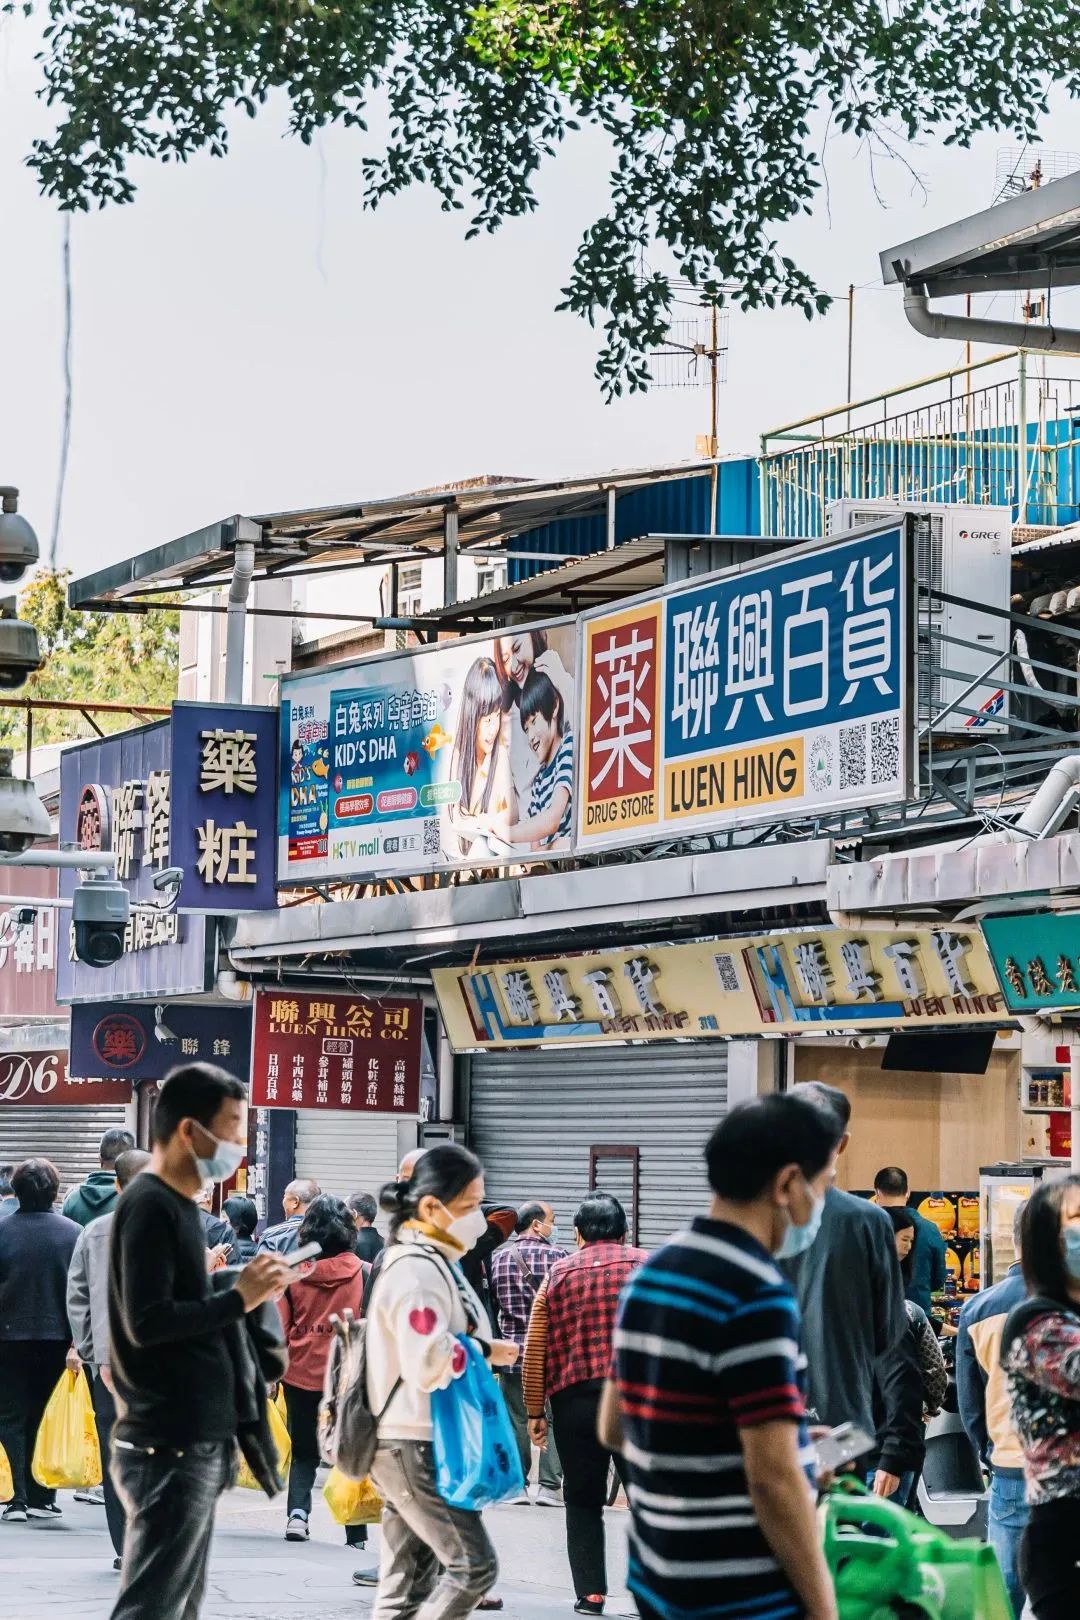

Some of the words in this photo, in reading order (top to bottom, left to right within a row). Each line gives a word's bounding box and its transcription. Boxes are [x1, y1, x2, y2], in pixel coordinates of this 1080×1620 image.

[971, 531, 1001, 540] GREE
[671, 552, 896, 740] 聯興百貨
[292, 705, 315, 721] 白兔系列
[335, 699, 385, 738] 白兔系列
[387, 689, 441, 731] 兒童魚油
[369, 736, 397, 762] DHA
[291, 784, 317, 807] DHA
[671, 761, 726, 813] LUEN
[733, 748, 798, 798] HING
[196, 728, 258, 885] 藥粧
[587, 801, 618, 826] DRUG
[620, 794, 655, 818] STORE
[332, 840, 357, 860] HKTV
[359, 838, 379, 857] mall
[269, 1000, 410, 1030] 聯興公司
[269, 1022, 317, 1036] LUEN
[326, 1025, 372, 1039] HING
[380, 1029, 409, 1041] CO.
[181, 1037, 231, 1056] 聯鋒
[326, 1041, 349, 1053] 經營
[267, 1054, 278, 1100] 日用百貨
[292, 1054, 304, 1101] 中西良藥
[317, 1056, 329, 1103] 參茸補品
[340, 1058, 353, 1104] 罐頭奶粉
[366, 1059, 379, 1105] 化粧香品
[394, 1060, 406, 1107] 高級絲襪
